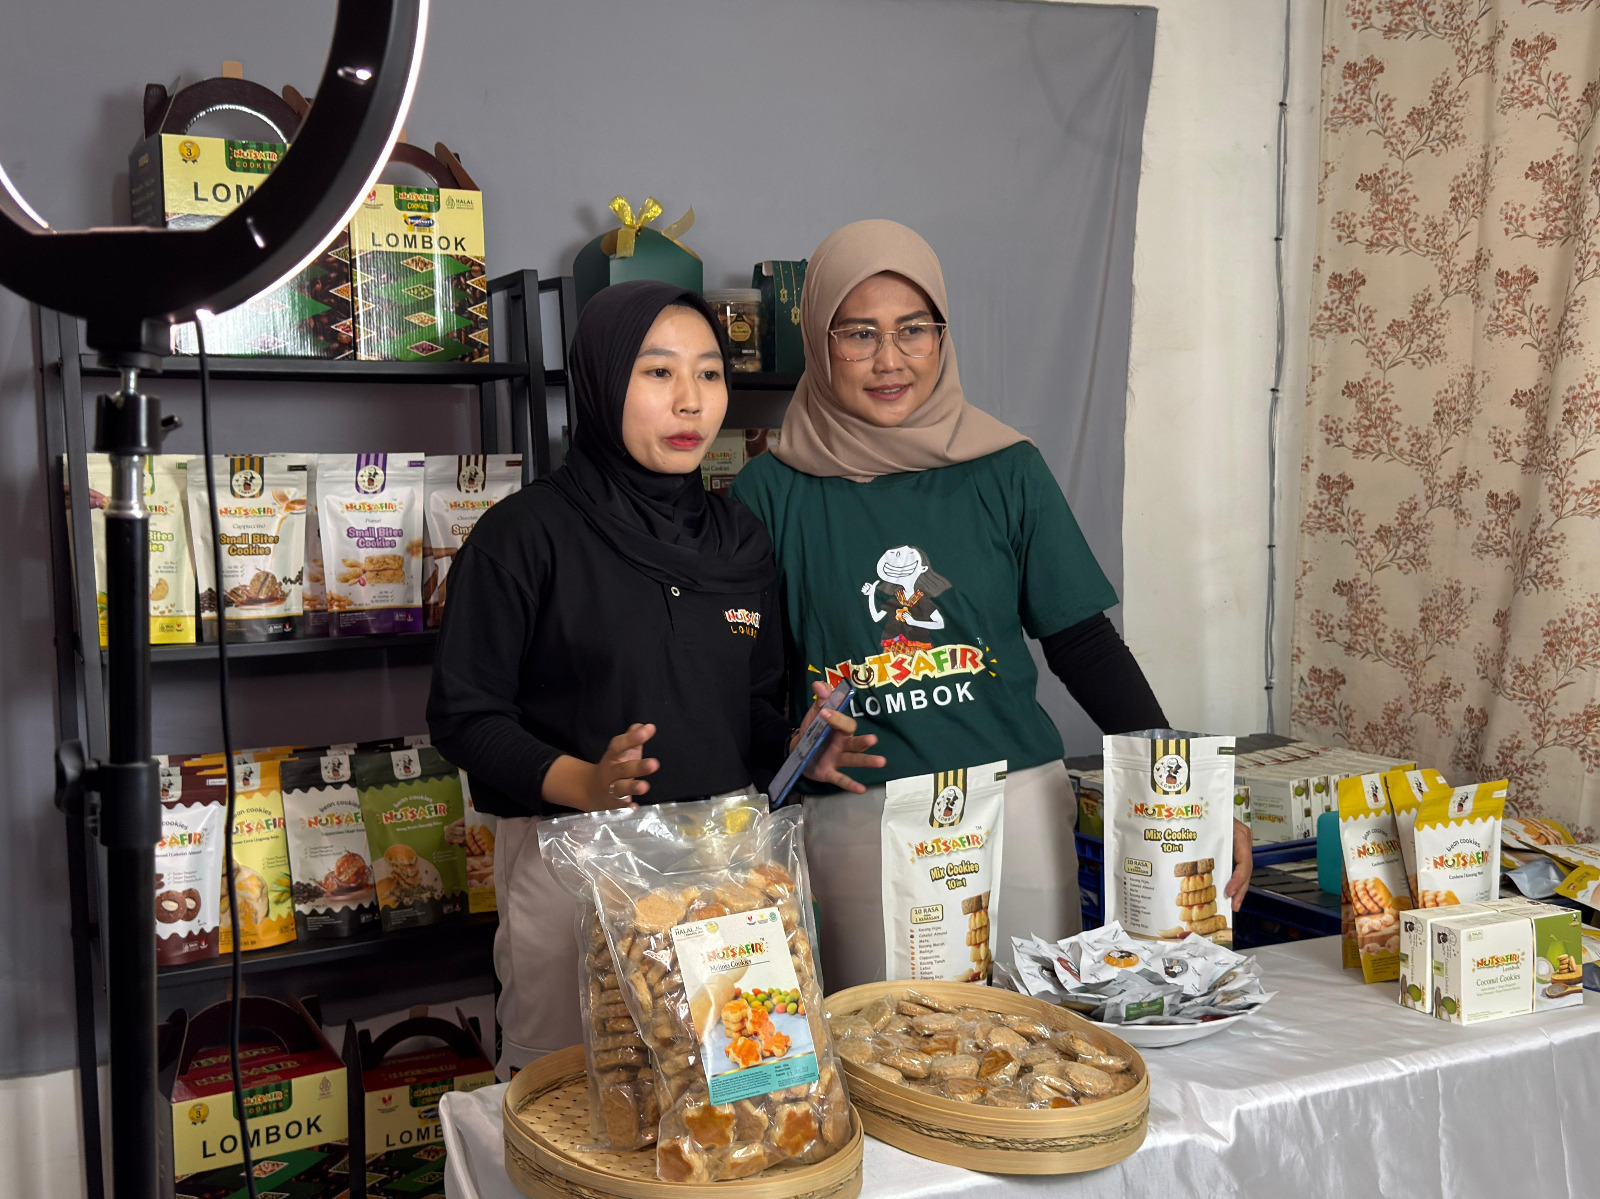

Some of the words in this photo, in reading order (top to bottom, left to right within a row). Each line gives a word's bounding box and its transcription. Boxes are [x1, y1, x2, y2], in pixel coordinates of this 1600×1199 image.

[193, 181, 257, 205] LOM
[371, 231, 467, 252] LOMBOK
[219, 506, 276, 517] NUTSAFIR
[219, 533, 250, 545] Small
[251, 533, 280, 545] Bites
[347, 527, 375, 538] Small
[376, 527, 404, 538] Bites
[227, 544, 272, 556] Cookies
[356, 537, 397, 549] Cookies
[825, 644, 986, 690] NUTSAFIR
[849, 681, 975, 718] LOMBOK
[1160, 780, 1184, 790] LOMBOK
[246, 806, 273, 816] cookies
[319, 801, 336, 812] bean
[382, 803, 448, 825] NUTSAFIR
[1133, 802, 1203, 821] NUTSAFIR
[307, 811, 363, 828] NUTSAF
[938, 812, 958, 822] LOMBOK
[161, 820, 189, 831] cookies
[232, 816, 286, 835] UTSAFIR
[157, 831, 203, 849] SAFIR
[1143, 828, 1162, 841] Mix
[1163, 827, 1198, 841] Cookies
[915, 834, 984, 858] NUTSAFIR
[1357, 839, 1401, 859] NUTSAFIR
[1446, 840, 1460, 852] bean
[1459, 838, 1481, 848] cookies
[1133, 860, 1149, 868] RASA
[1432, 850, 1489, 870] NUTSAFIR
[930, 866, 946, 882] Mix
[946, 860, 980, 877] Cookies
[923, 906, 939, 914] RASA
[706, 942, 766, 963] NUTSAFIR
[730, 959, 752, 968] Cookies
[1476, 953, 1520, 969] NUTSAFIR
[1476, 977, 1499, 987] Coconut
[1499, 973, 1521, 983] Cookies
[249, 1101, 284, 1114] OOKIES
[203, 1115, 323, 1159] LOMBOK
[385, 1124, 444, 1148] LOMB
